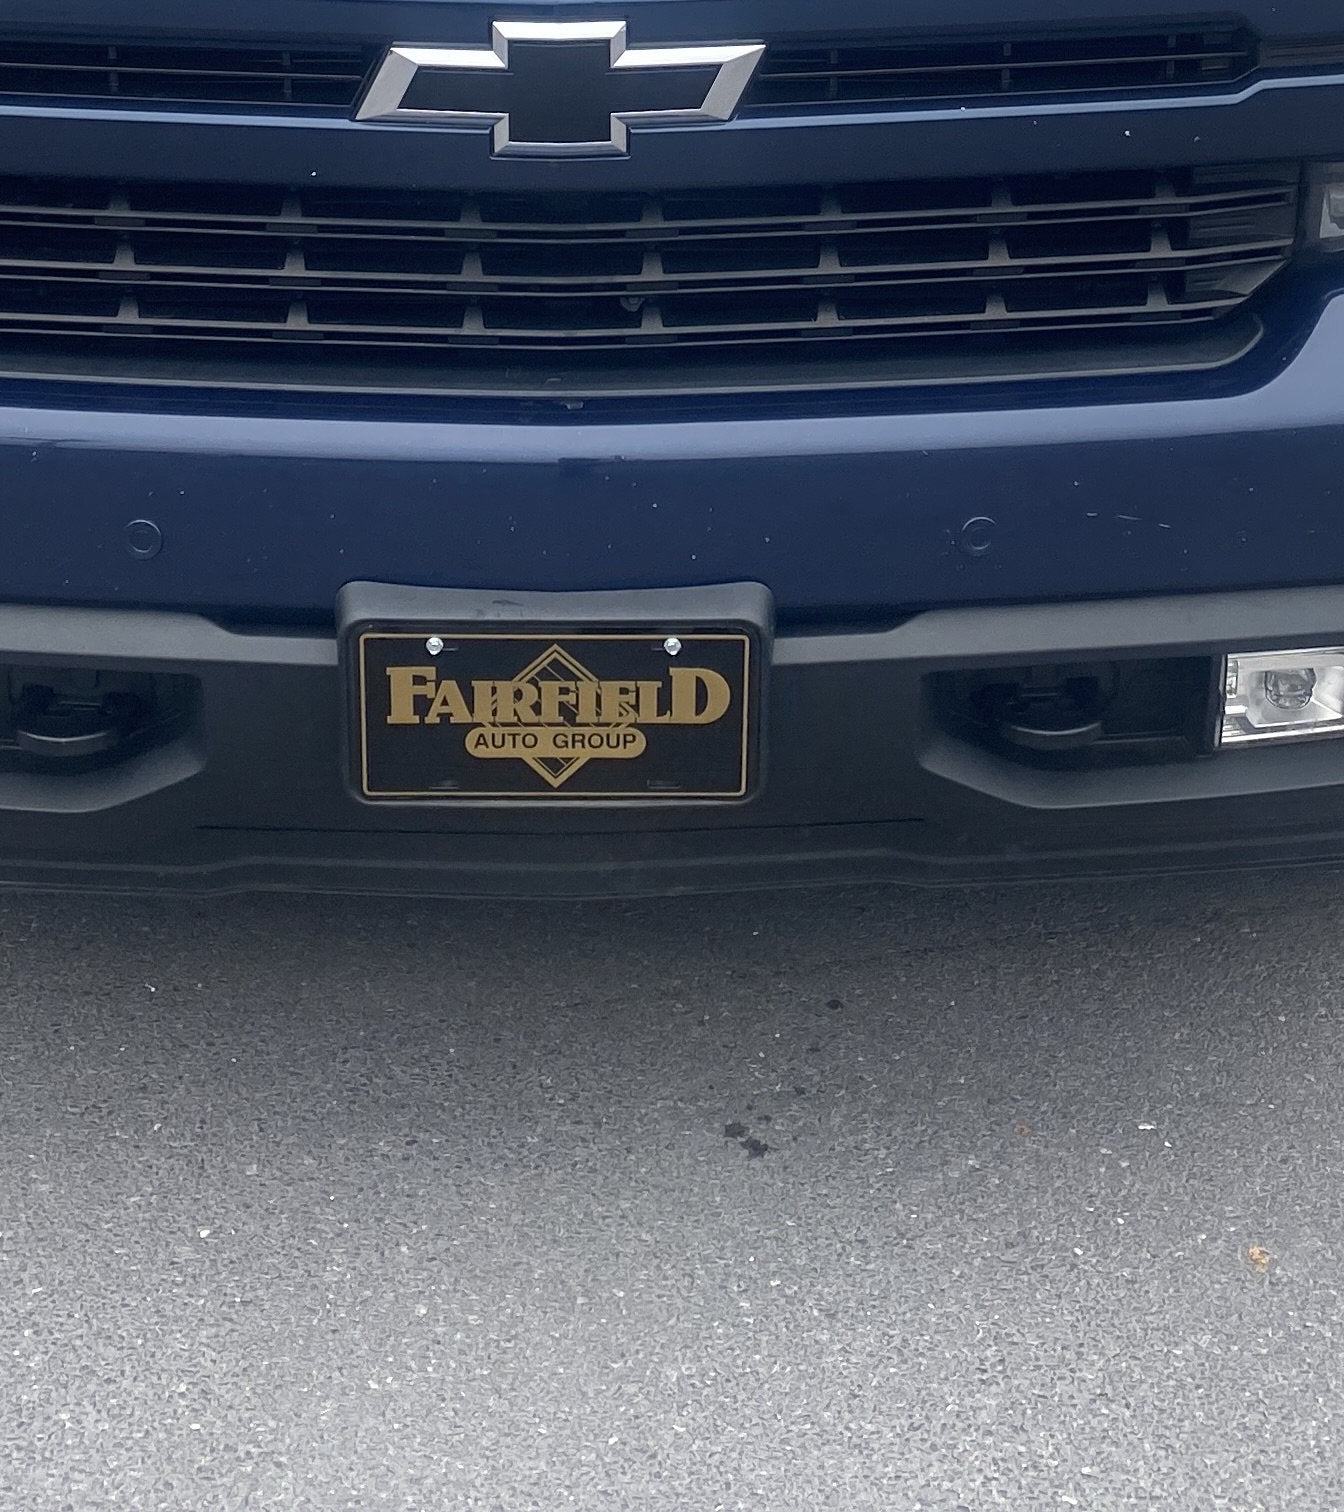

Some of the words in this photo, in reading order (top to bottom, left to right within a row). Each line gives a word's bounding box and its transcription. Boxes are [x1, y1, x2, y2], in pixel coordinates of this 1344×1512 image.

[386, 666, 731, 724] FAIRFIELD
[474, 733, 539, 749] AUTO
[552, 733, 637, 750] GROUP
